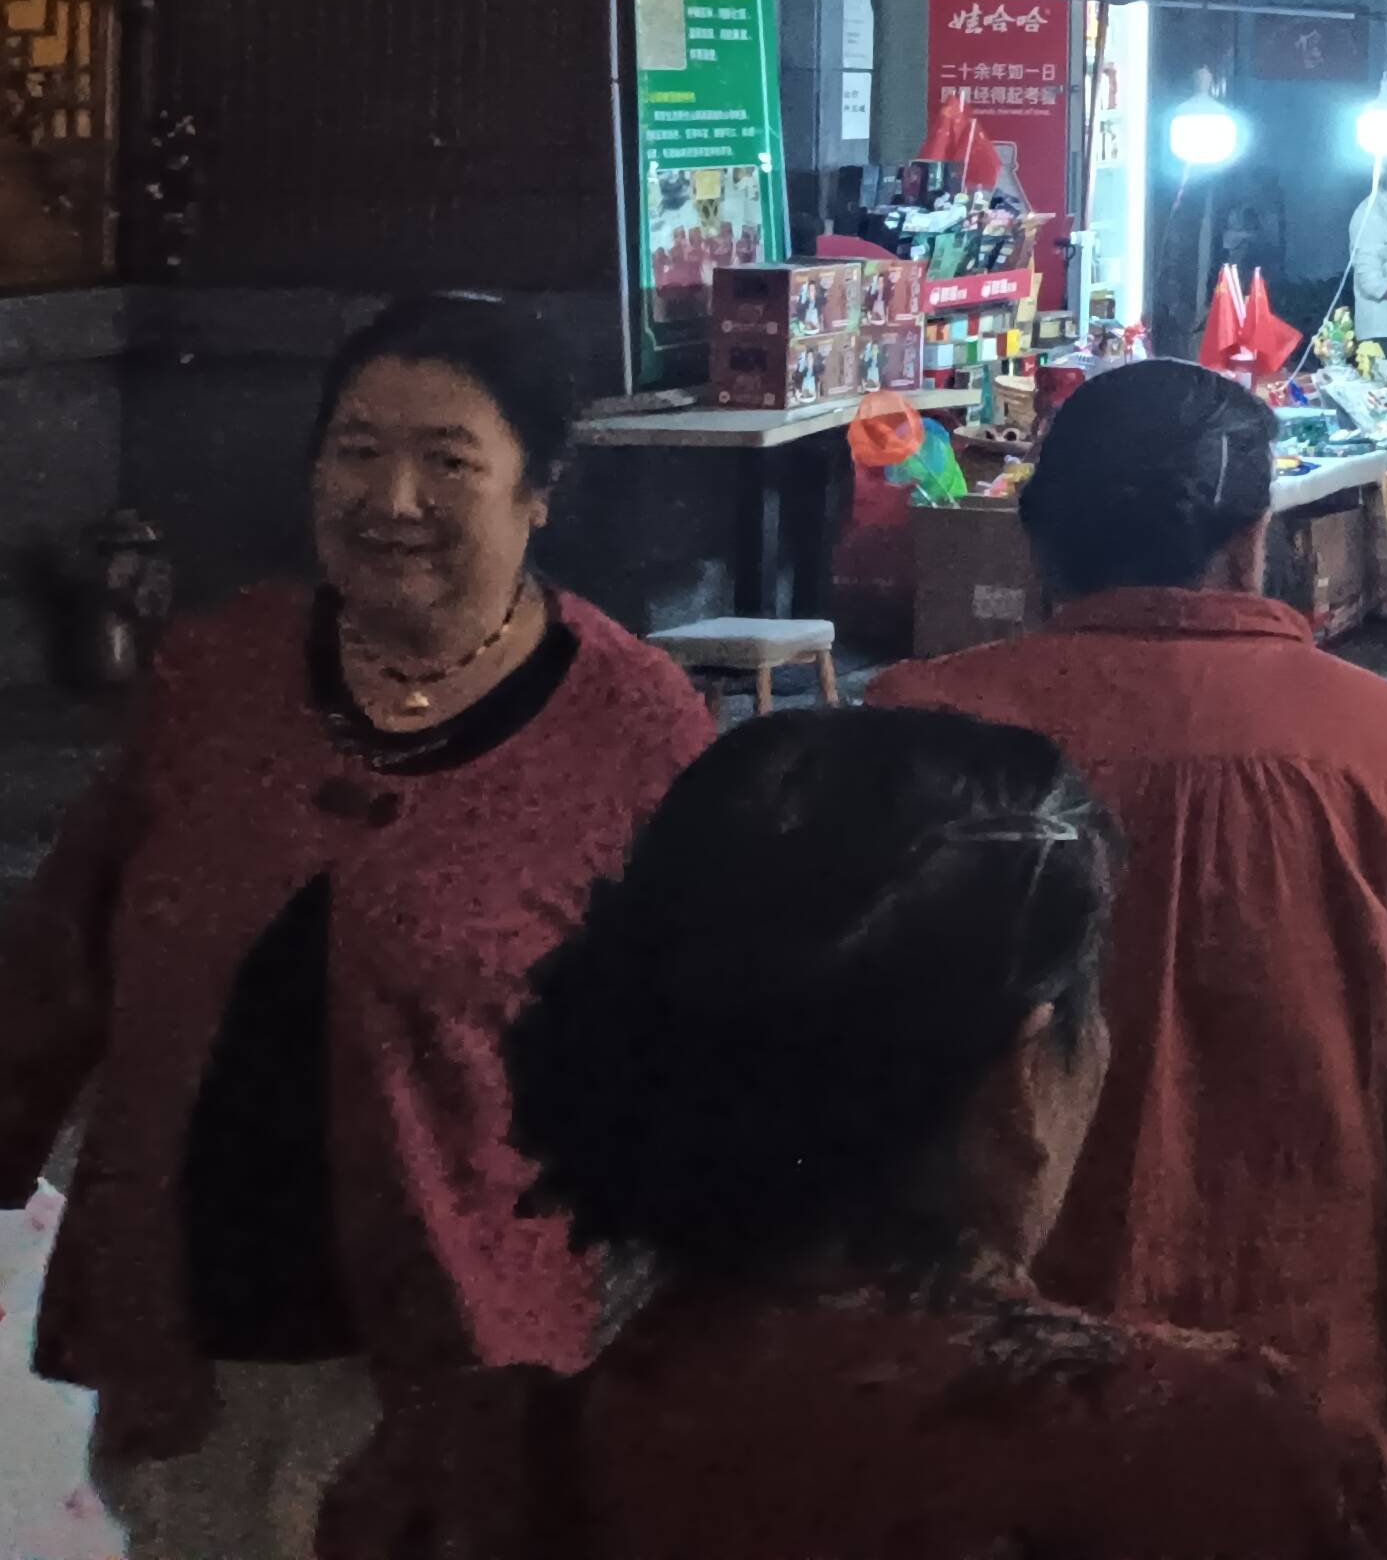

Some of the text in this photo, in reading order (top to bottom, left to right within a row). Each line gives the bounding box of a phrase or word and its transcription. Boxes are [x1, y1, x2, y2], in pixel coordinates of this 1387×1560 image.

[947, 2, 1049, 35] 娃哈哈
[940, 61, 1057, 82] 二十余年如一日
